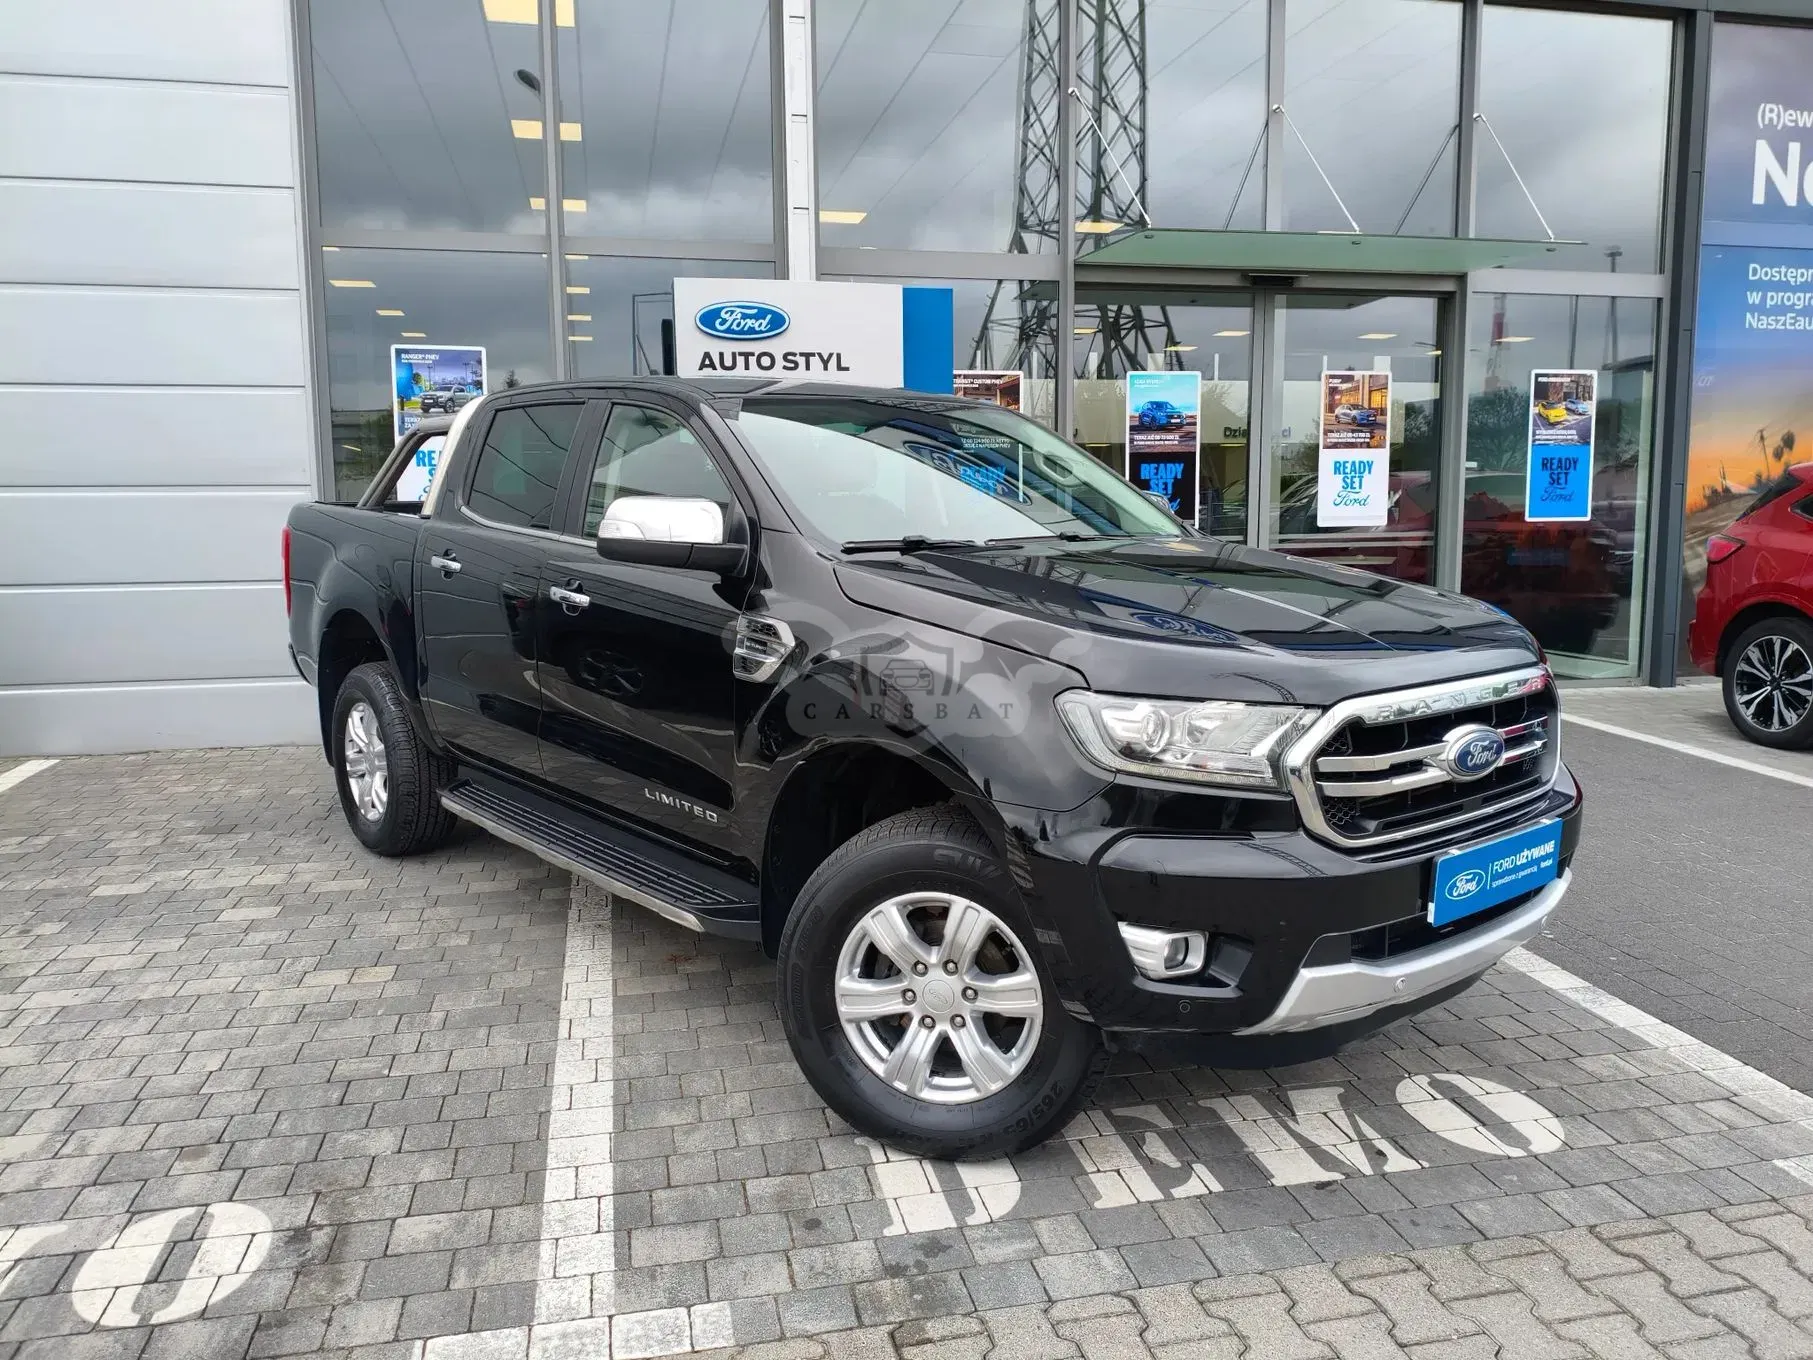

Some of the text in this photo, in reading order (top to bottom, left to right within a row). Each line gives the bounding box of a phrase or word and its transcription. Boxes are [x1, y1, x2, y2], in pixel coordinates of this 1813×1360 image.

[1752, 139, 1813, 207] N
[1746, 291, 1813, 309] w progr
[715, 306, 772, 332] Ford
[698, 351, 850, 372] AUTO STYL
[1224, 426, 1248, 438] Dzia
[1141, 463, 1184, 479] READY
[1334, 461, 1373, 475] READY
[1542, 457, 1579, 471] READY
[1150, 479, 1174, 494] SET
[1342, 475, 1364, 490] SET
[1549, 472, 1570, 486] SET
[1333, 490, 1371, 507] Ford
[1541, 486, 1575, 502] Ford
[1467, 740, 1498, 767] Ford
[644, 788, 718, 823] LIMITED
[1493, 840, 1555, 874] FORD UŻYWANE
[1452, 874, 1479, 897] Ford
[854, 1072, 1566, 1237] DEMO
